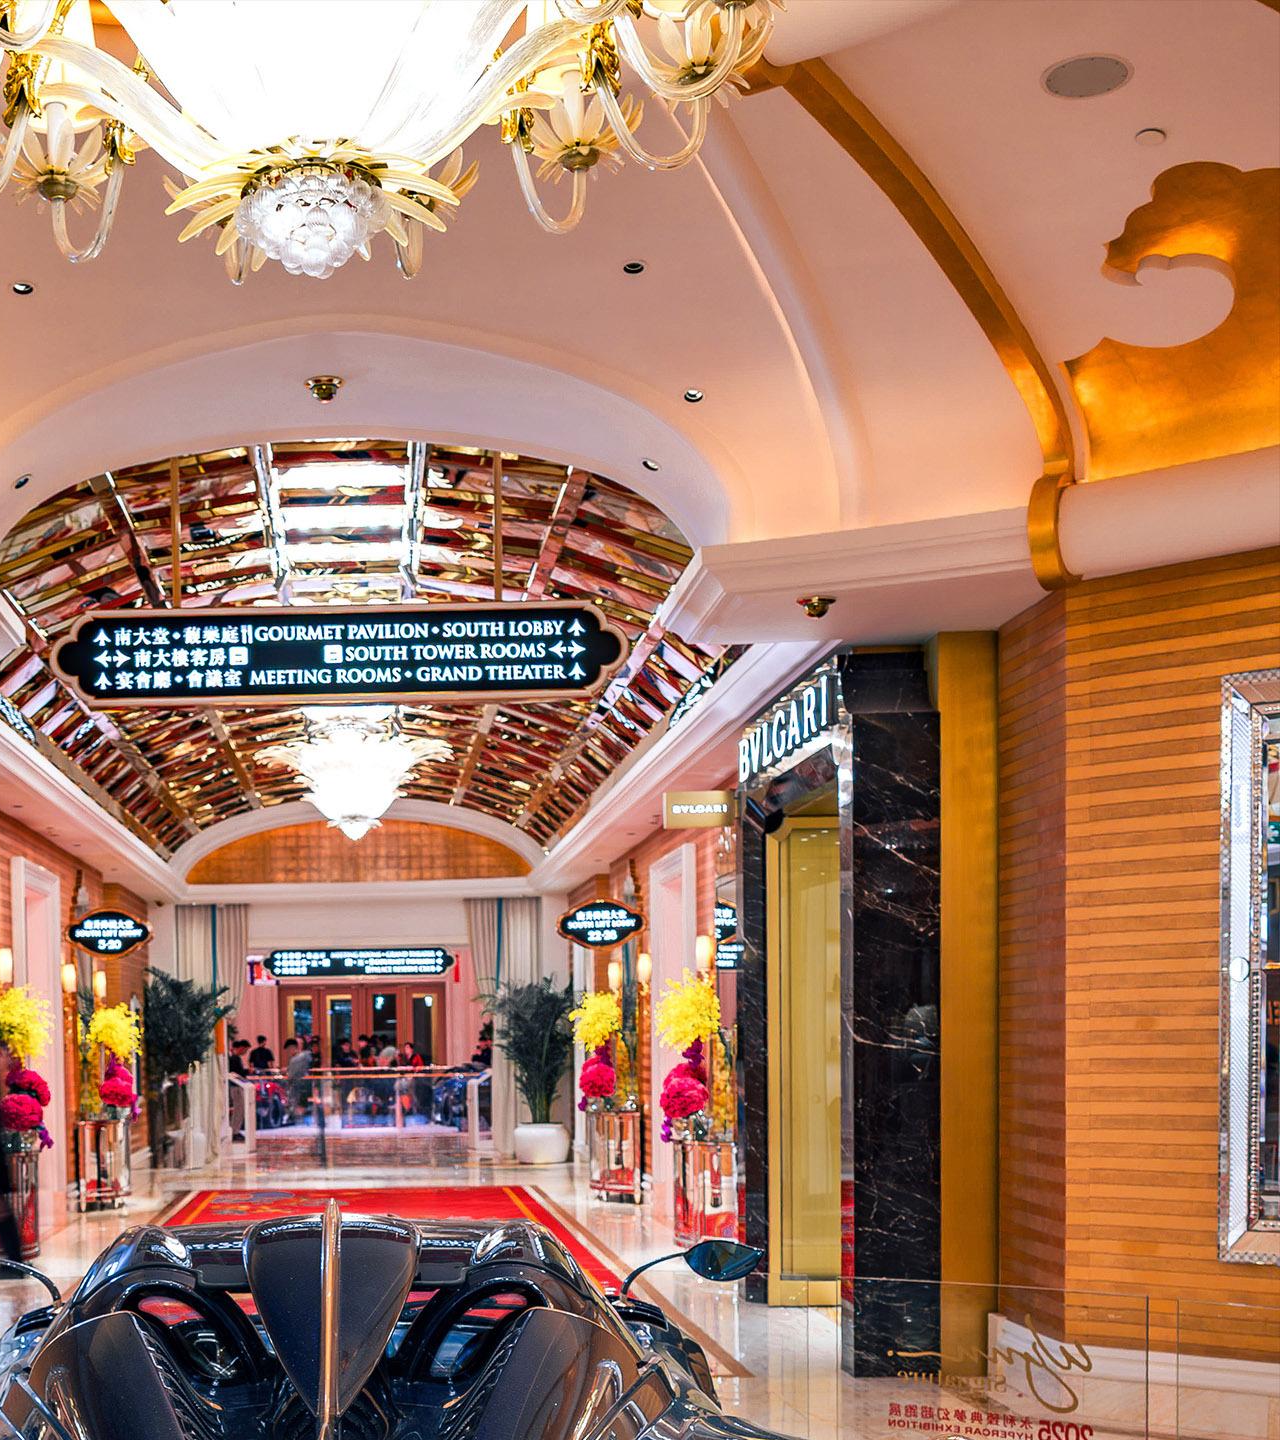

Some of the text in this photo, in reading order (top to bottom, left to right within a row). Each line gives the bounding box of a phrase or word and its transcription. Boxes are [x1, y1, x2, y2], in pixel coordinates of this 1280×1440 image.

[114, 626, 171, 647] 南大堂
[254, 619, 565, 642] GOURMET PAVILION SOUTH LOBBY
[345, 641, 547, 662] SOUTH TOWER ROOMS
[248, 663, 568, 686] MEETING ROOMS GRAND THEATER
[738, 674, 828, 784] BVLGARI
